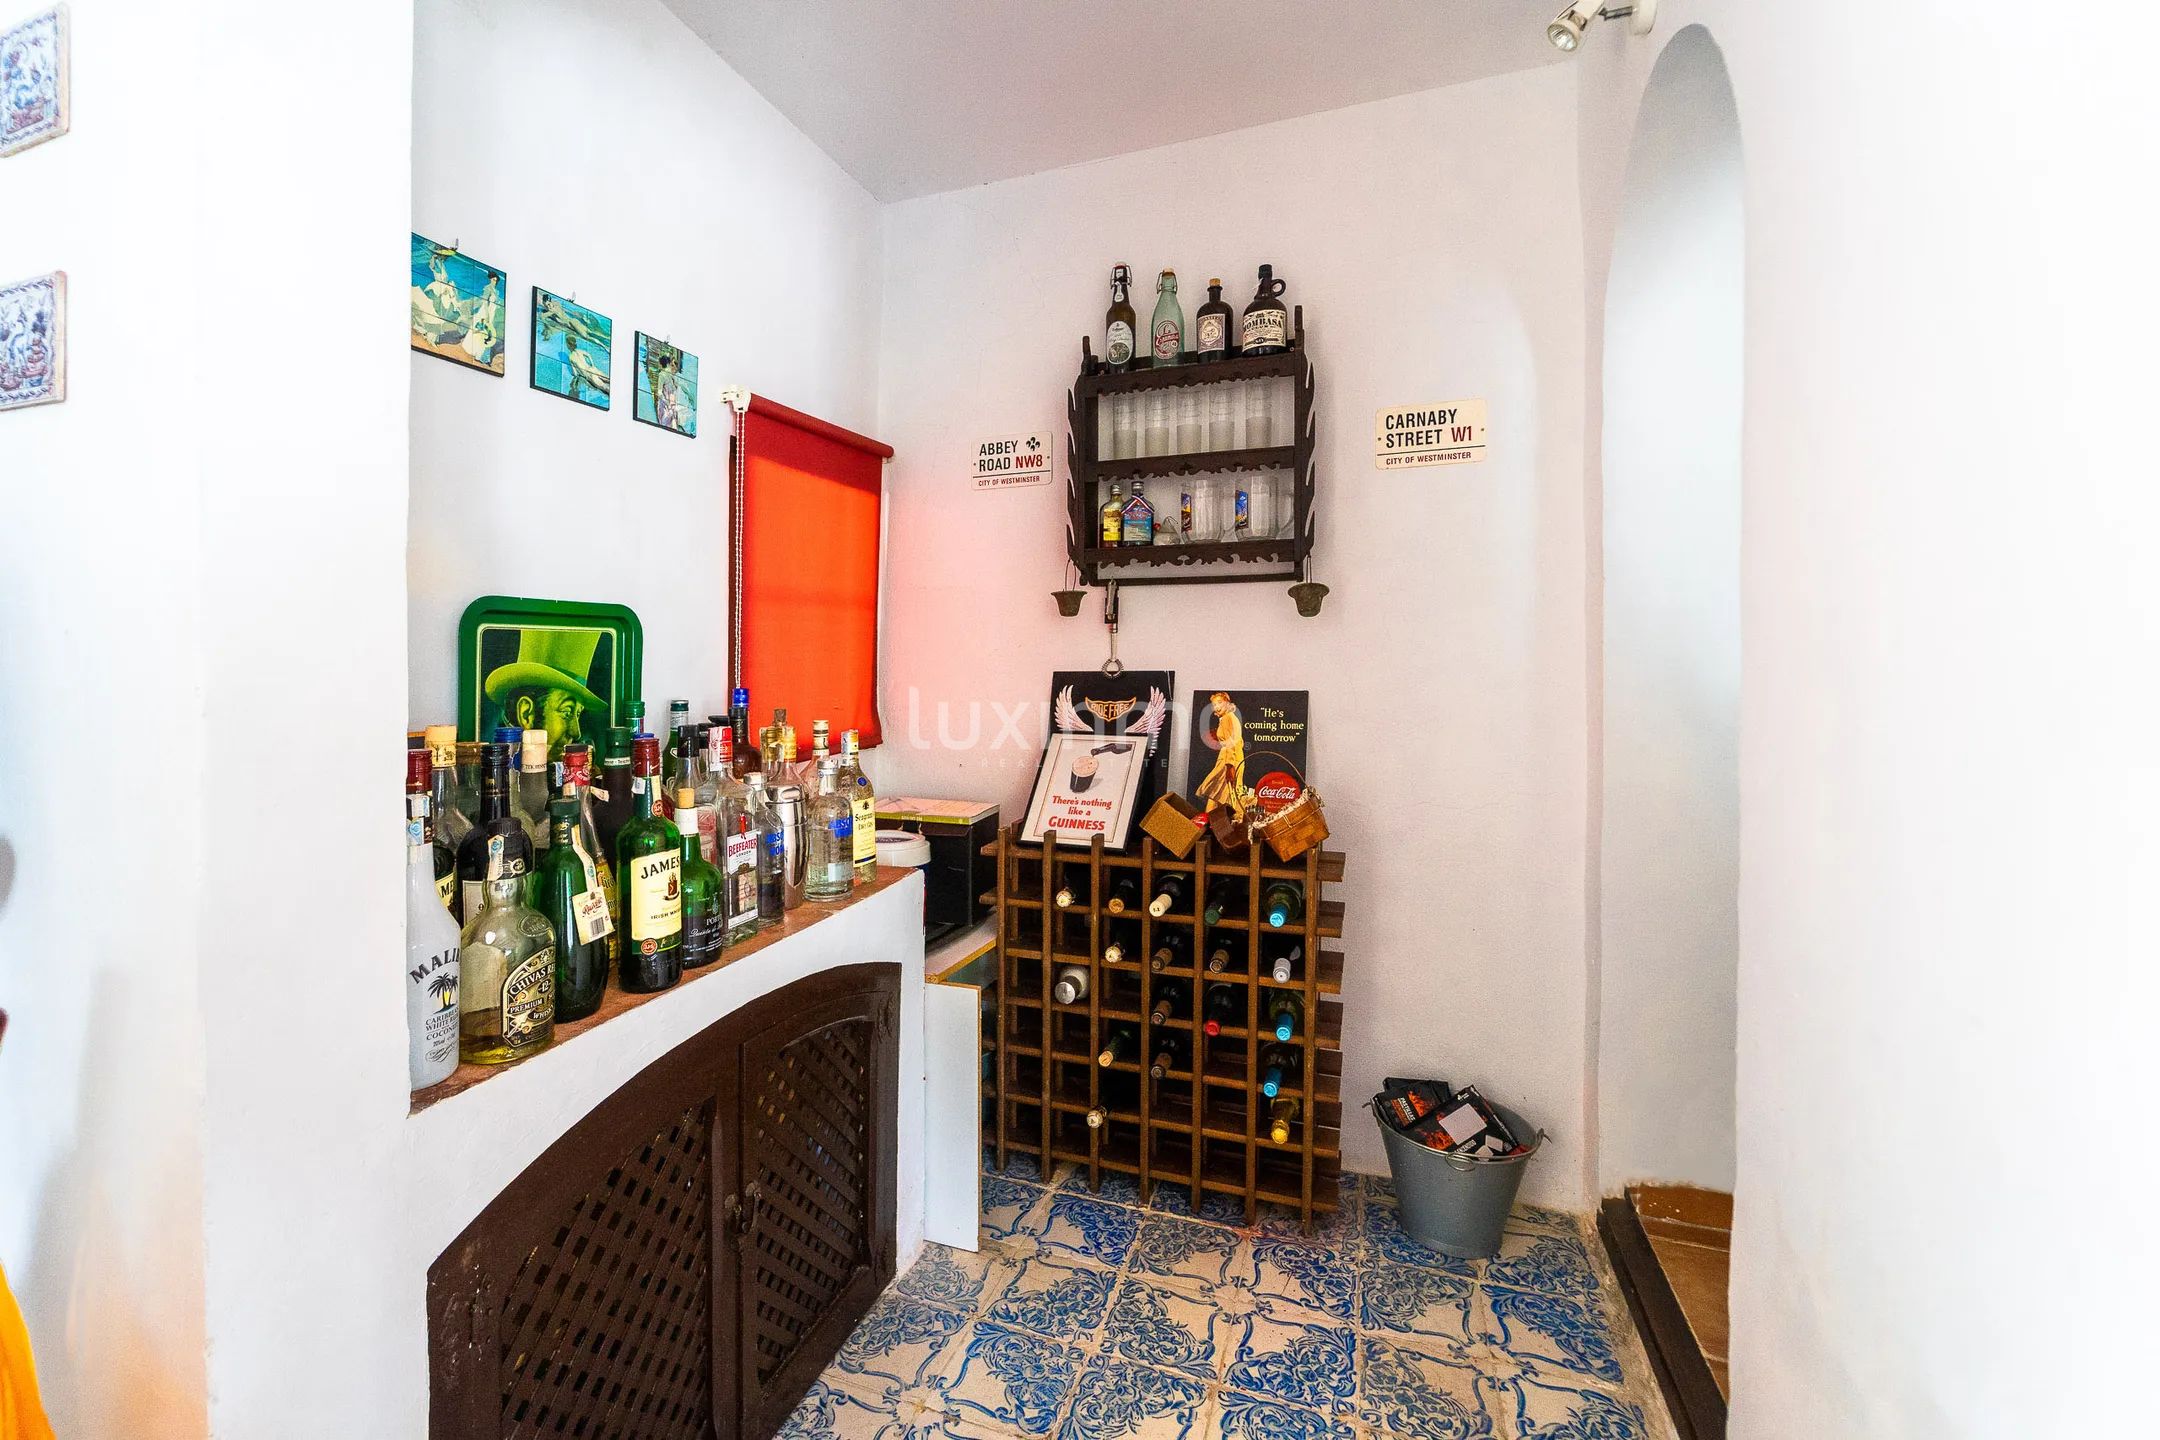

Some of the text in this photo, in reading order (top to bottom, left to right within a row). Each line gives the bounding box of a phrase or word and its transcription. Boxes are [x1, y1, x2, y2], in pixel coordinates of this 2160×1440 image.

[1385, 408, 1457, 430] CARNABY
[1386, 426, 1472, 448] STREET W1
[979, 440, 1018, 456] ABBEY
[979, 454, 1043, 472] ROAD NW8
[1386, 457, 1402, 465] CITY
[1417, 451, 1471, 462] WESTMINSTER
[1001, 475, 1040, 484] WESTMINSTER
[1091, 703, 1130, 718] RIDE FREE
[1244, 720, 1304, 731] coming home
[1254, 732, 1300, 742] tomorrow"
[1052, 795, 1112, 811] There's nothing
[1067, 806, 1084, 816] like
[1048, 816, 1106, 831] GUINNESS
[728, 838, 757, 857] BEEFEATER
[640, 855, 680, 880] JAMES
[509, 967, 546, 995] CHIVAS
[541, 980, 549, 992] 12
[510, 998, 543, 1013] PREMIUM
